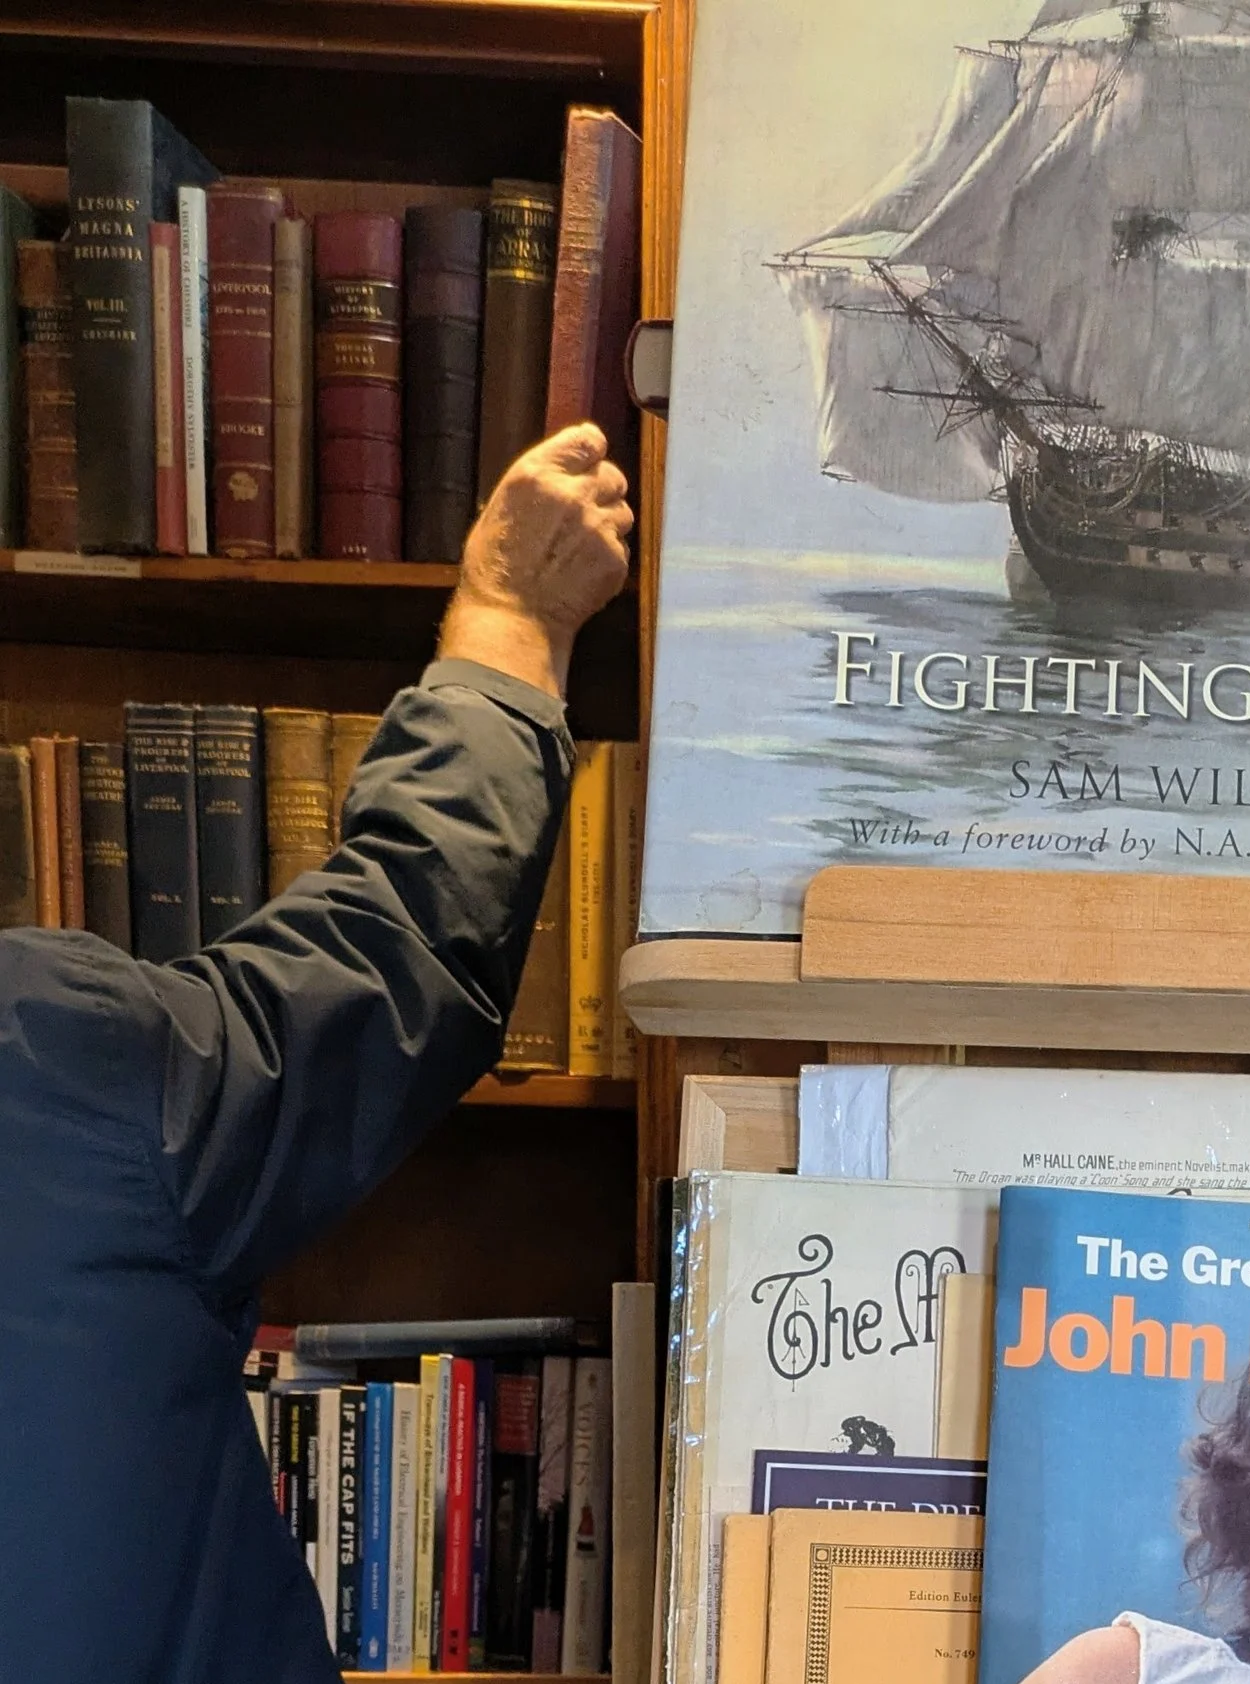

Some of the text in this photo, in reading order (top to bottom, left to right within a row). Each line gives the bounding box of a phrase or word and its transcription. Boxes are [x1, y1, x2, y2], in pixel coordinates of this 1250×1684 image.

[182, 209, 190, 257] HISTORY
[1008, 760, 1125, 804] SAM
[849, 817, 924, 849] With
[933, 832, 951, 849] a
[960, 820, 1110, 857] foreword
[1121, 826, 1156, 860] by
[1043, 1154, 1075, 1170] HALL
[1138, 1160, 1182, 1172] eminent
[1076, 1235, 1168, 1281] The
[1002, 1288, 1227, 1382] John
[340, 1402, 356, 1565] IF THE CAP FITS
[908, 1589, 950, 1602] Edition
[934, 1647, 976, 1660] No. 749
